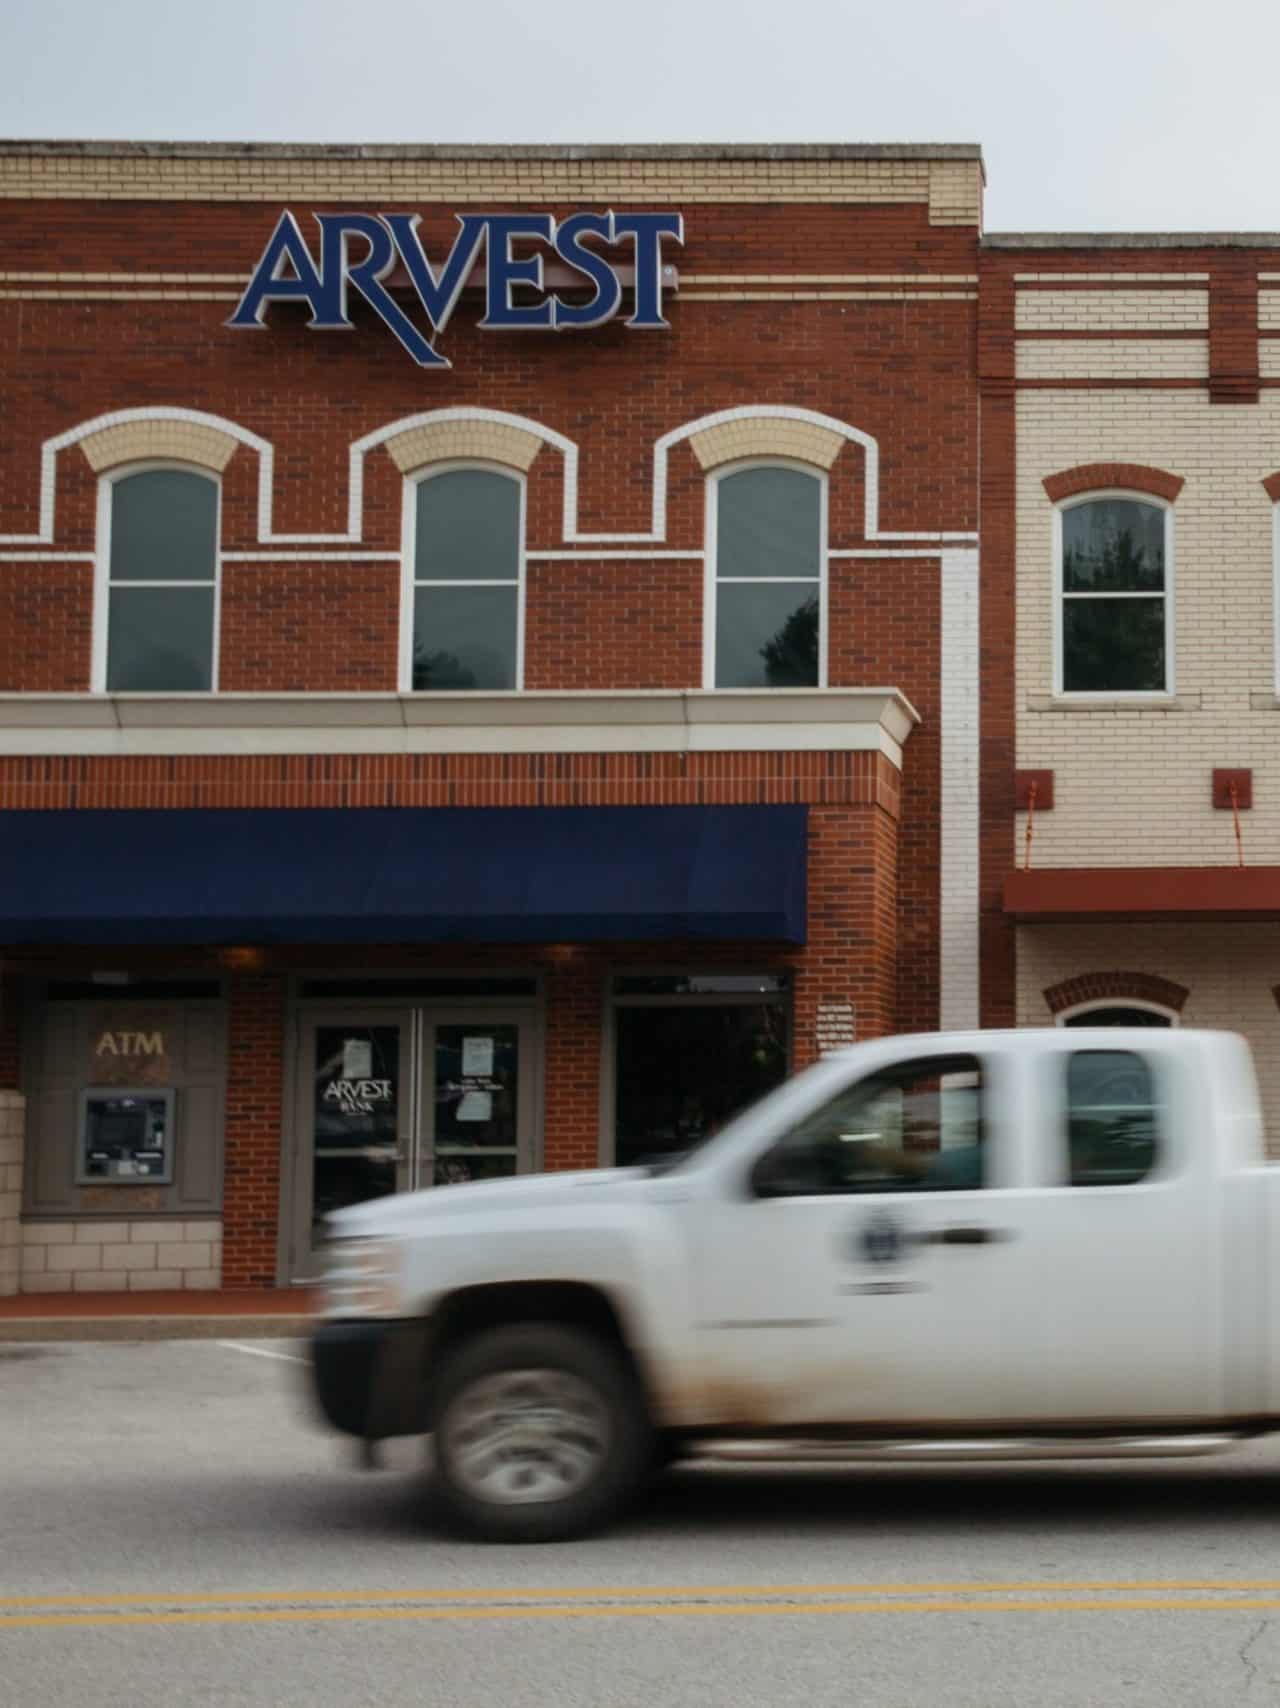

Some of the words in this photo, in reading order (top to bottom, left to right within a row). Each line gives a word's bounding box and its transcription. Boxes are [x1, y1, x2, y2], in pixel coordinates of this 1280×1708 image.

[223, 208, 685, 369] ARVEST
[96, 1031, 164, 1056] ATM
[323, 1080, 392, 1104] ARVEST
